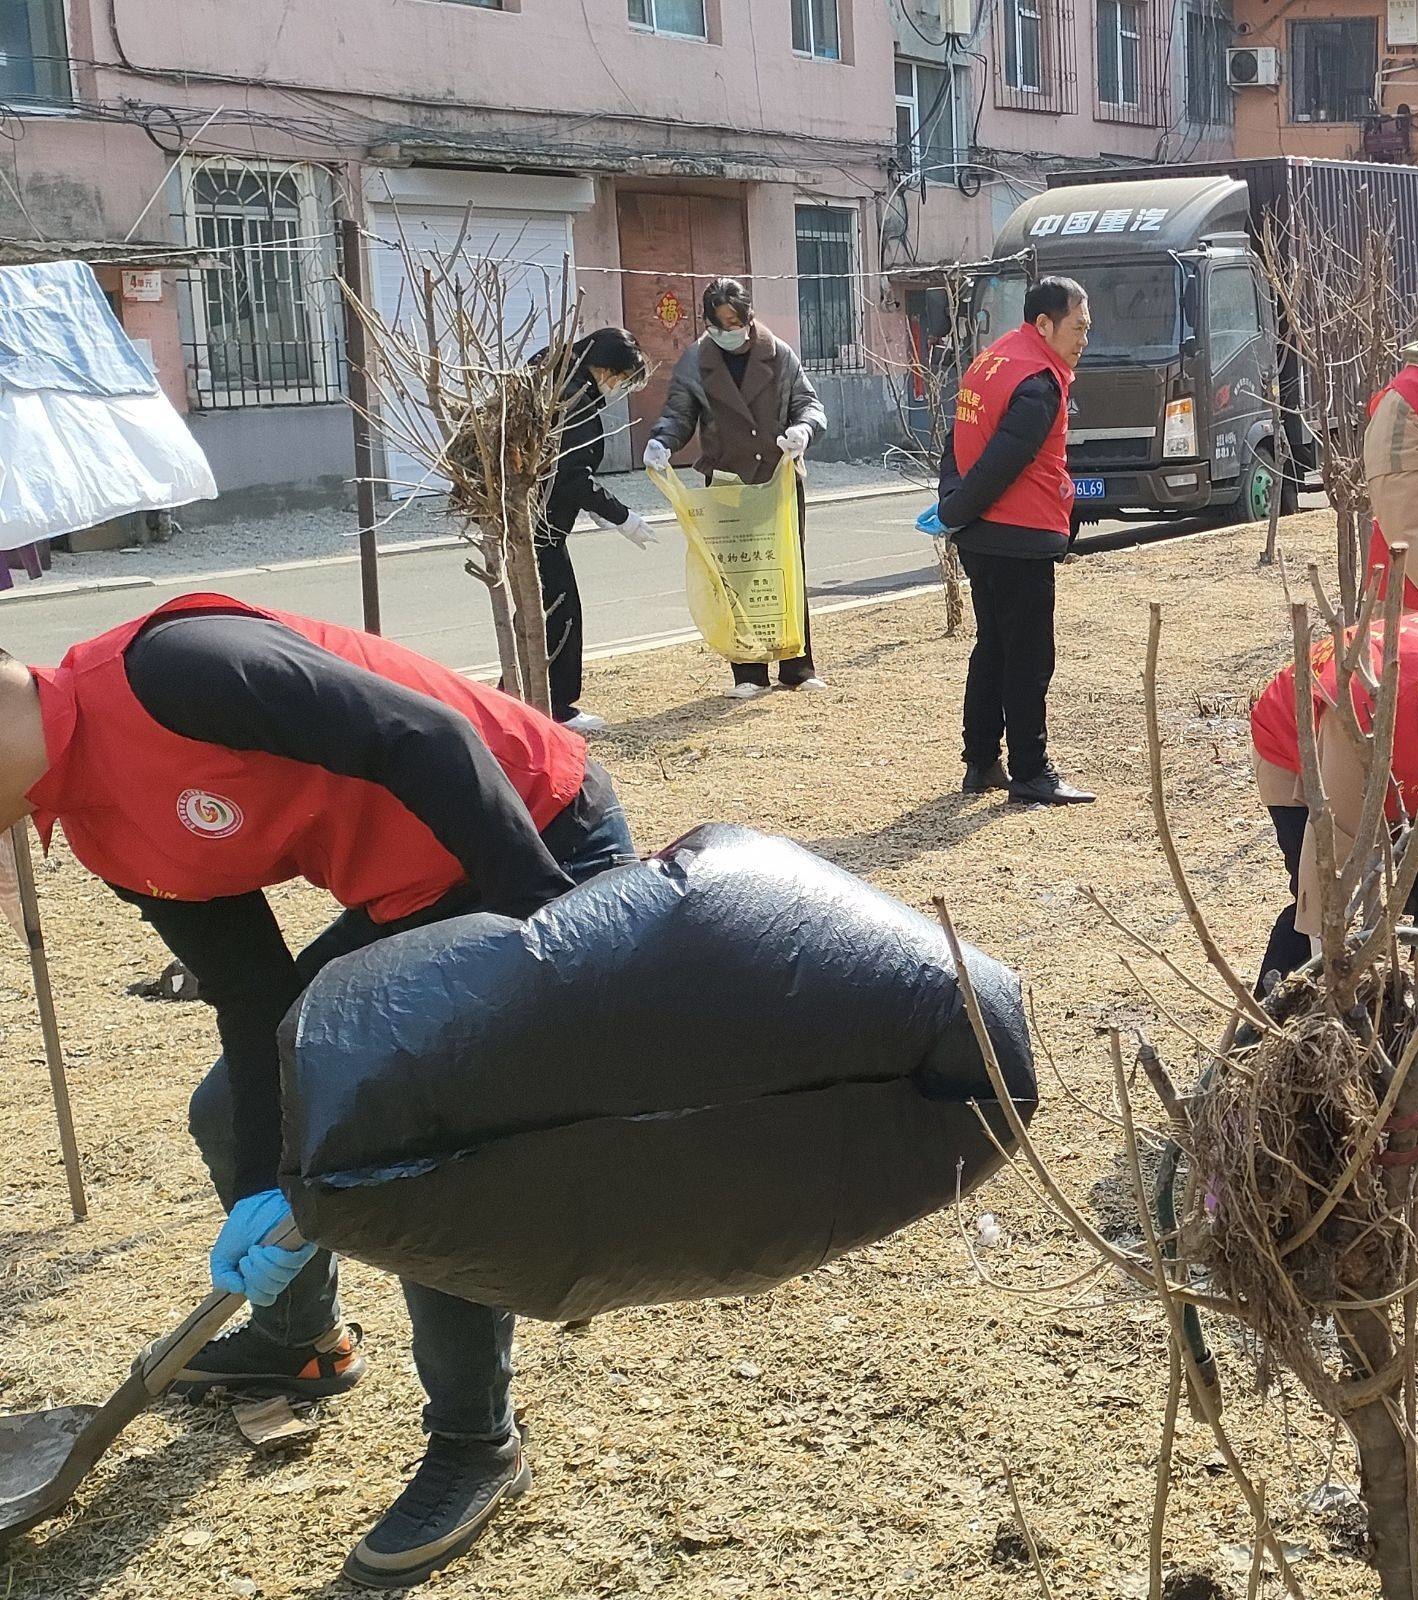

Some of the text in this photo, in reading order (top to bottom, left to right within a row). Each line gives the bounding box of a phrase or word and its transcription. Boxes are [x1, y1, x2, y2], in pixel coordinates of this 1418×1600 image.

[1029, 208, 1169, 236] 中国重汽
[1076, 481, 1103, 495] 6L69
